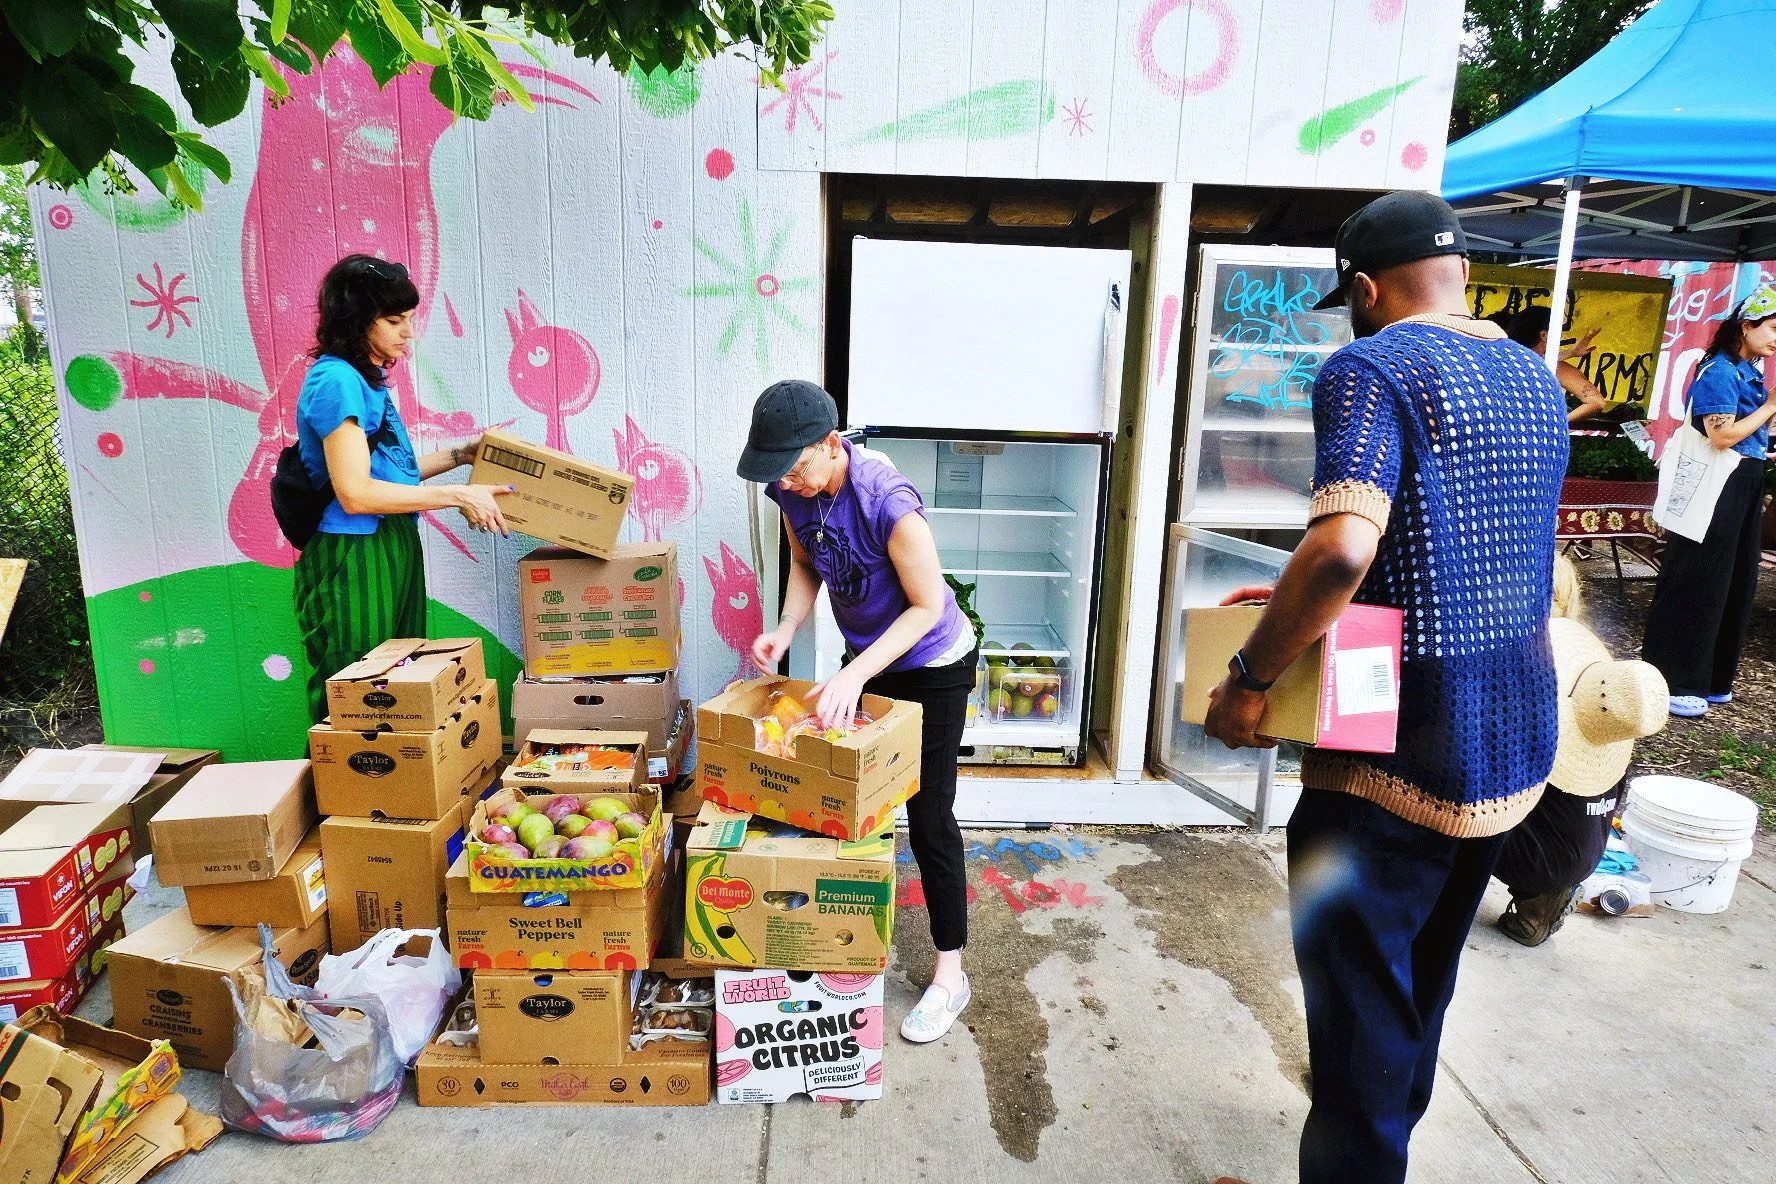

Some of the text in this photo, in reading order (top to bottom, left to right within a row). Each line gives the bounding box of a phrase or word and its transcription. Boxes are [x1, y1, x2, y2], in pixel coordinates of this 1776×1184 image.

[1571, 348, 1654, 402] ARMS
[341, 712, 422, 720] www.taylorfarms.com
[356, 756, 389, 765] Taylor
[704, 763, 728, 772] nature
[704, 769, 722, 778] fresh
[750, 762, 800, 785] Poivrons
[704, 776, 725, 786] farms
[761, 778, 788, 793] doux
[822, 794, 846, 806] nature
[822, 801, 841, 812] fresh
[821, 808, 844, 820] farms
[481, 864, 628, 880] GUATEMANGO
[52, 880, 74, 902] VIFON
[702, 886, 750, 898] Del Monte
[819, 890, 876, 903] Premium
[818, 904, 885, 916] BANANAS
[509, 917, 582, 928] Sweet Bell
[518, 929, 575, 942] Peppers
[66, 931, 84, 954] VIFON
[724, 976, 786, 992] FRUIT
[814, 980, 866, 1000] FRUITWORLDCO.COM
[722, 986, 792, 1004] WORLD
[526, 998, 566, 1008] Taylor
[149, 1004, 192, 1018] CRAISINS
[142, 1018, 202, 1035] CRANBERRIES
[735, 1008, 868, 1049] ORGANIC
[752, 1036, 860, 1070] CITRUS
[808, 1062, 862, 1078] DELICIOUSLY
[671, 1079, 687, 1088] 100
[814, 1072, 860, 1084] DIFFERENT
[442, 1080, 456, 1090] 30
